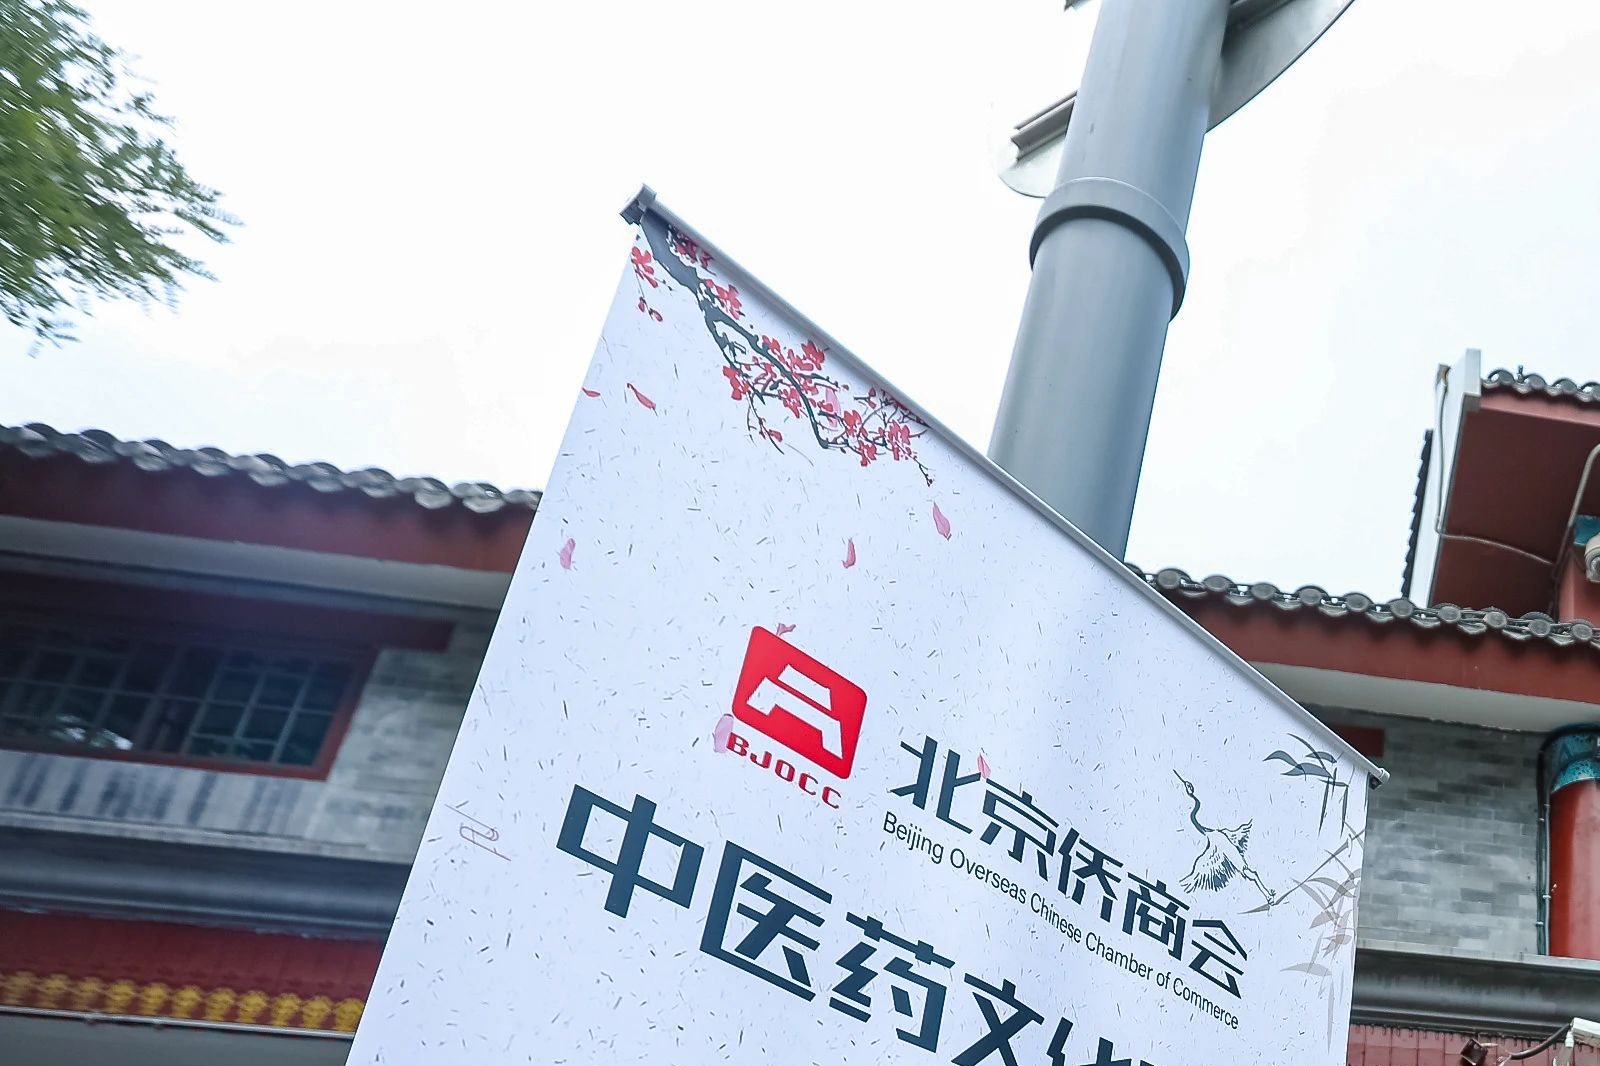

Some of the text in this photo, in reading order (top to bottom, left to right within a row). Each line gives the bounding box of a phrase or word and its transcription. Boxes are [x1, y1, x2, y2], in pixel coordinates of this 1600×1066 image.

[726, 731, 842, 809] BJOCC
[888, 736, 1248, 1000] 北京侨商会
[883, 811, 1240, 1030] Beijing Overseas Chinese Chamber of Commerce
